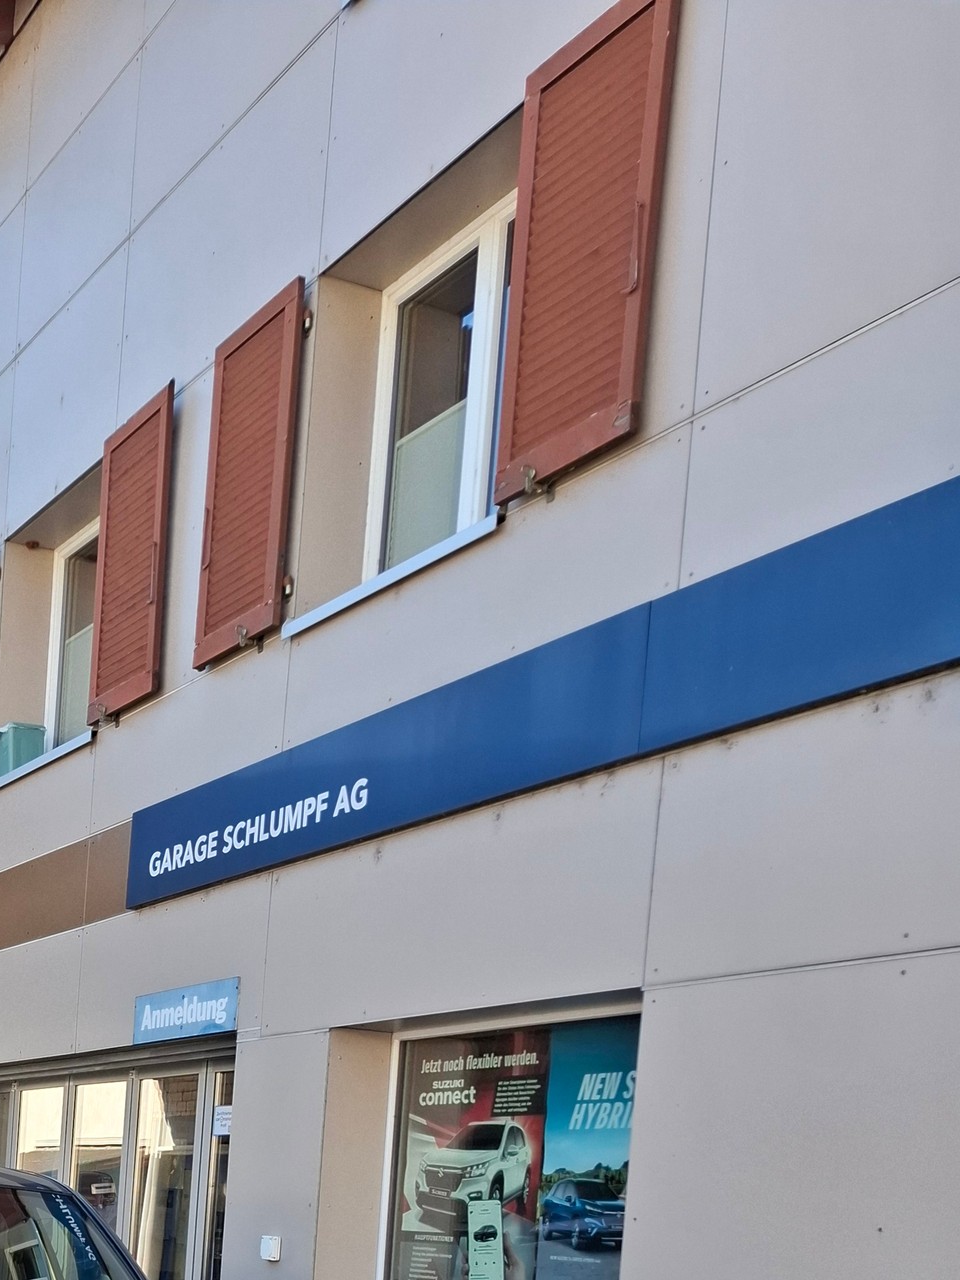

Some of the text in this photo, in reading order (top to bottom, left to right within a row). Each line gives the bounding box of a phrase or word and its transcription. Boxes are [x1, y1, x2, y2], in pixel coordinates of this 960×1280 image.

[148, 777, 369, 877] GARAGE SCHLUMPF AG
[140, 994, 229, 1031] Anmeldung
[420, 1049, 539, 1074] Jetzt noch flexibler werden.
[418, 1085, 477, 1106] connect
[432, 1078, 465, 1089] SUZUKI
[577, 1071, 623, 1101] NEW
[568, 1101, 634, 1130] HYBRI
